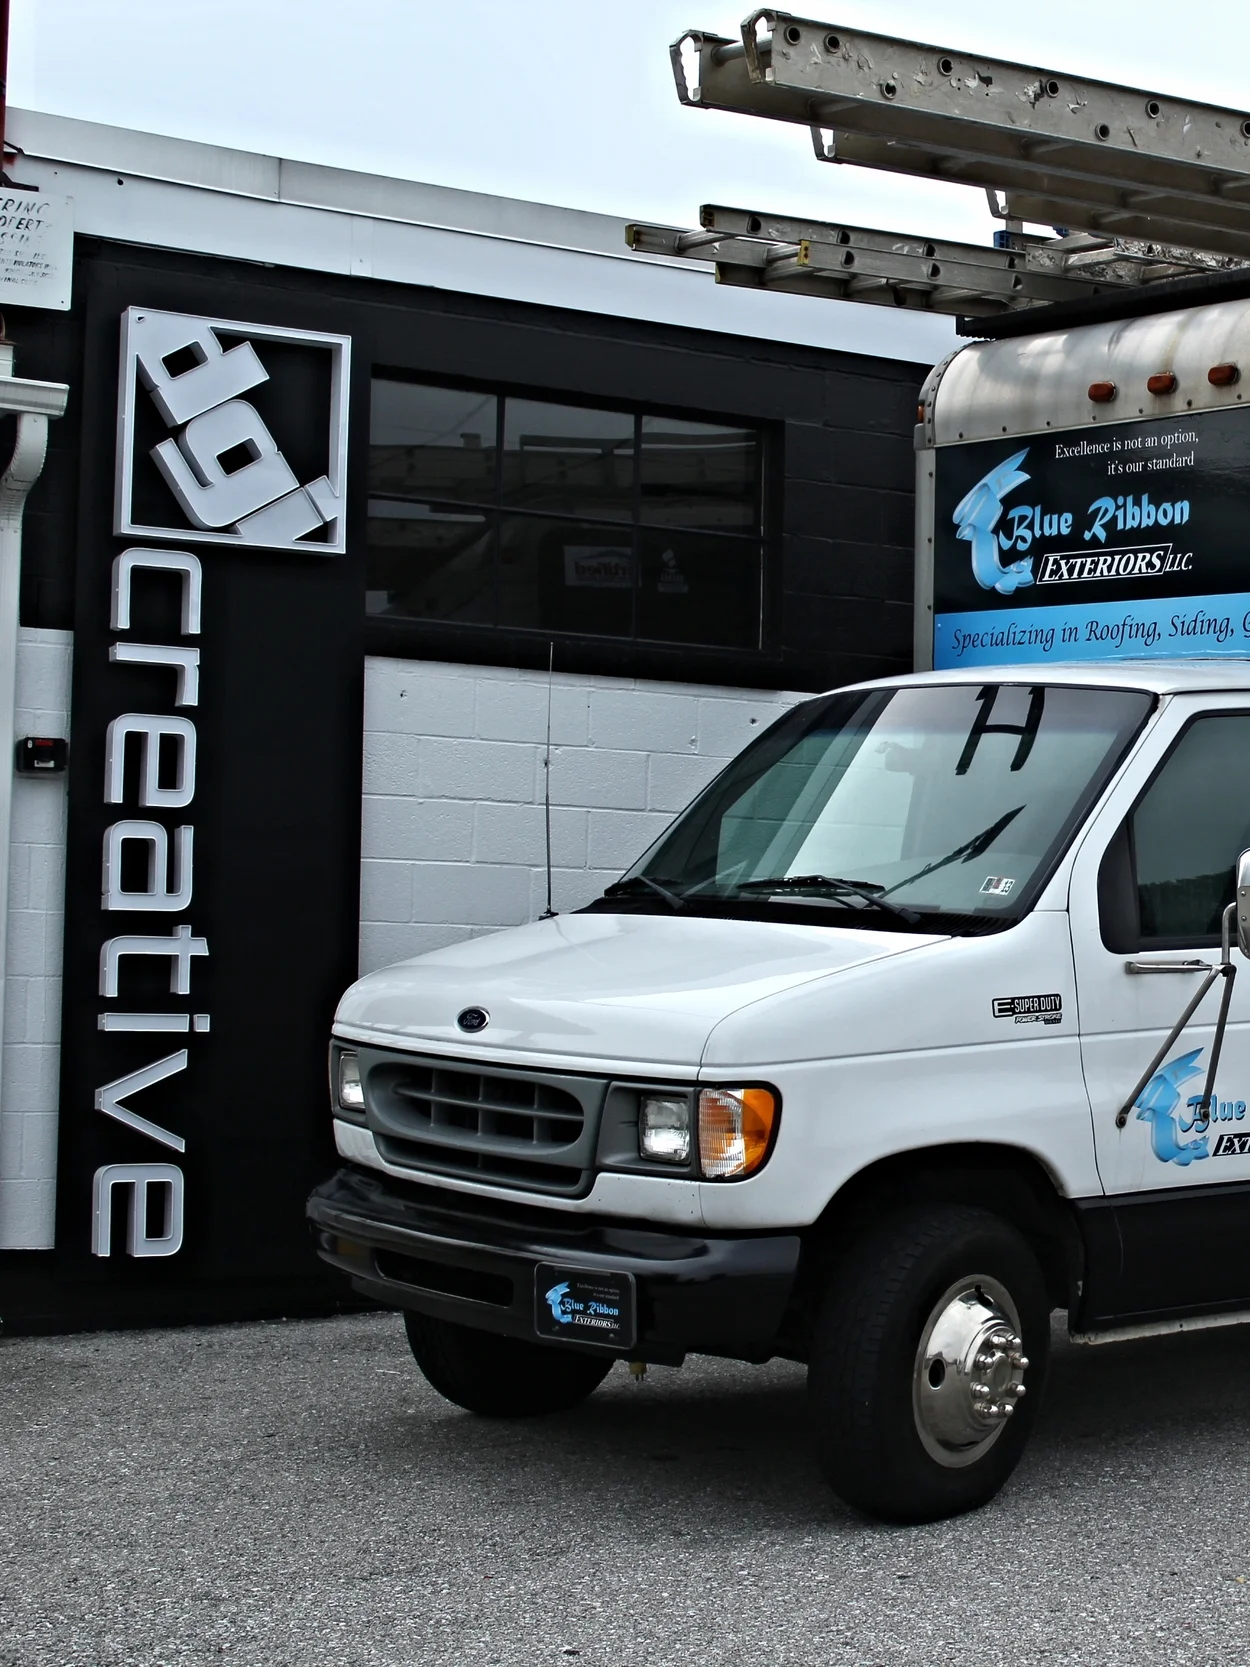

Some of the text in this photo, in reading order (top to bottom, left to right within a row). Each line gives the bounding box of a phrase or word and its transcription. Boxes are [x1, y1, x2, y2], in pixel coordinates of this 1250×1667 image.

[1055, 429, 1199, 459] Excellence is not an option,
[1107, 451, 1194, 475] it's our standard
[999, 492, 1190, 551] Blue Ribbon
[1041, 550, 1193, 582] EXTERIORS LLC.
[951, 621, 1055, 657] Specializing
[1061, 621, 1080, 643] in
[1085, 616, 1162, 648] Roofing,
[1168, 610, 1235, 643] Siding,
[92, 547, 210, 1258] creative
[1040, 996, 1060, 1010] DUTY
[463, 1012, 480, 1026] Ford
[1178, 1093, 1246, 1133] Blue
[560, 1298, 619, 1316] Blue Ribbon
[574, 1315, 611, 1329] EXTERIORS
